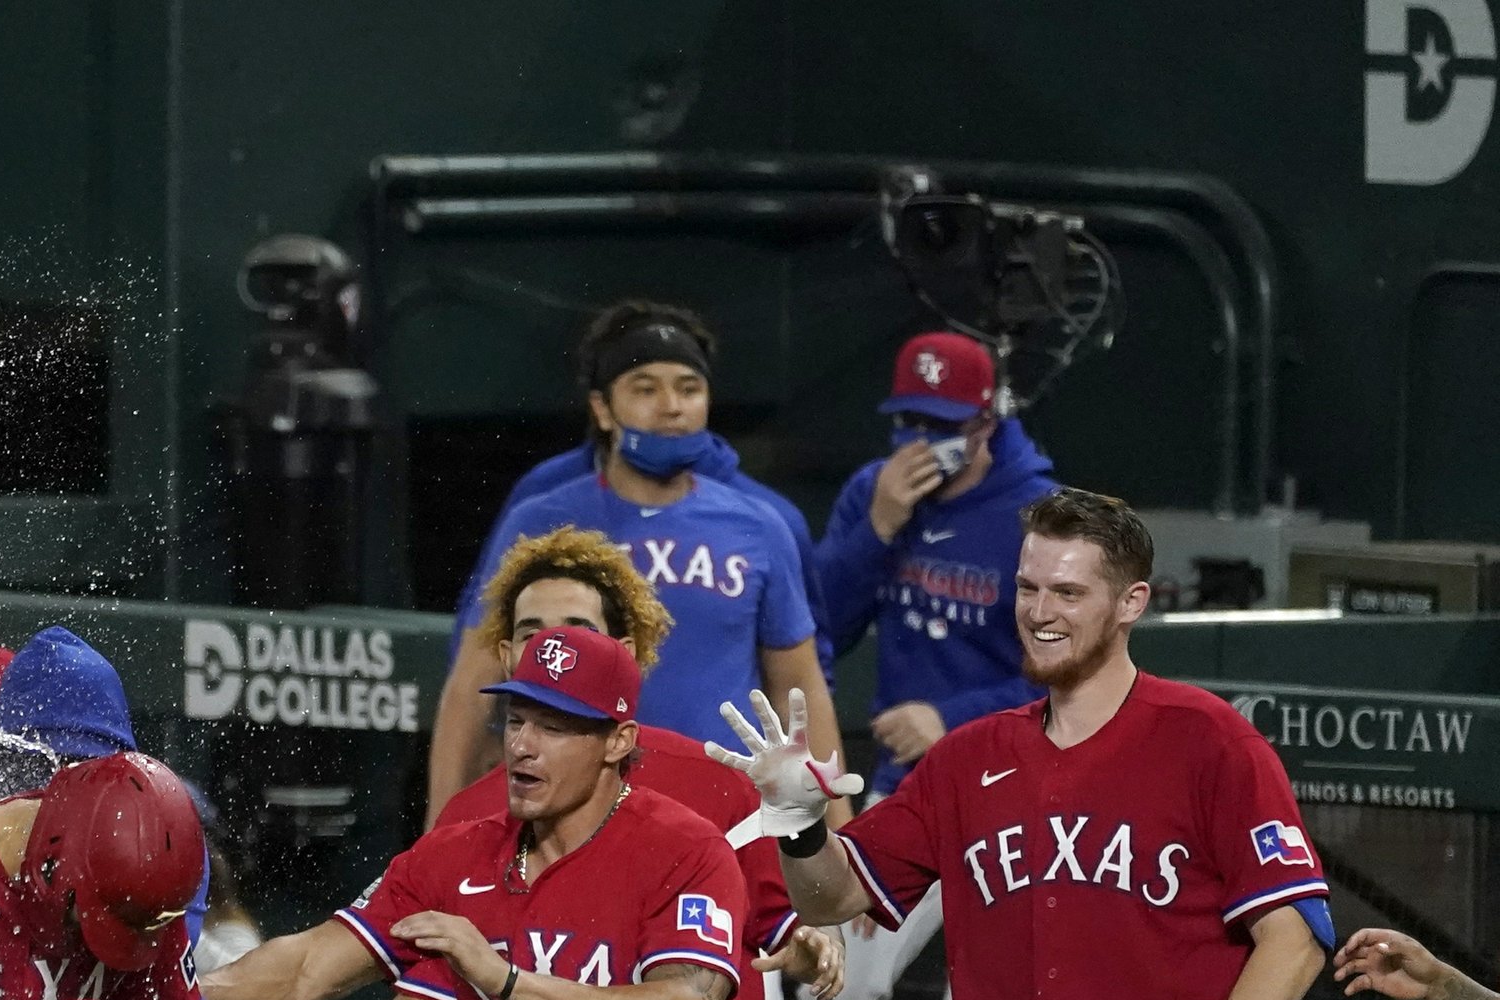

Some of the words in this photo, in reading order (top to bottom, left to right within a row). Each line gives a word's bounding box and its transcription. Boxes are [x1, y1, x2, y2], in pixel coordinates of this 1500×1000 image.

[616, 540, 749, 598] XAS
[247, 624, 395, 681] DALLAS
[246, 674, 420, 732] COLLEGE
[964, 815, 1190, 907] TEXAS
